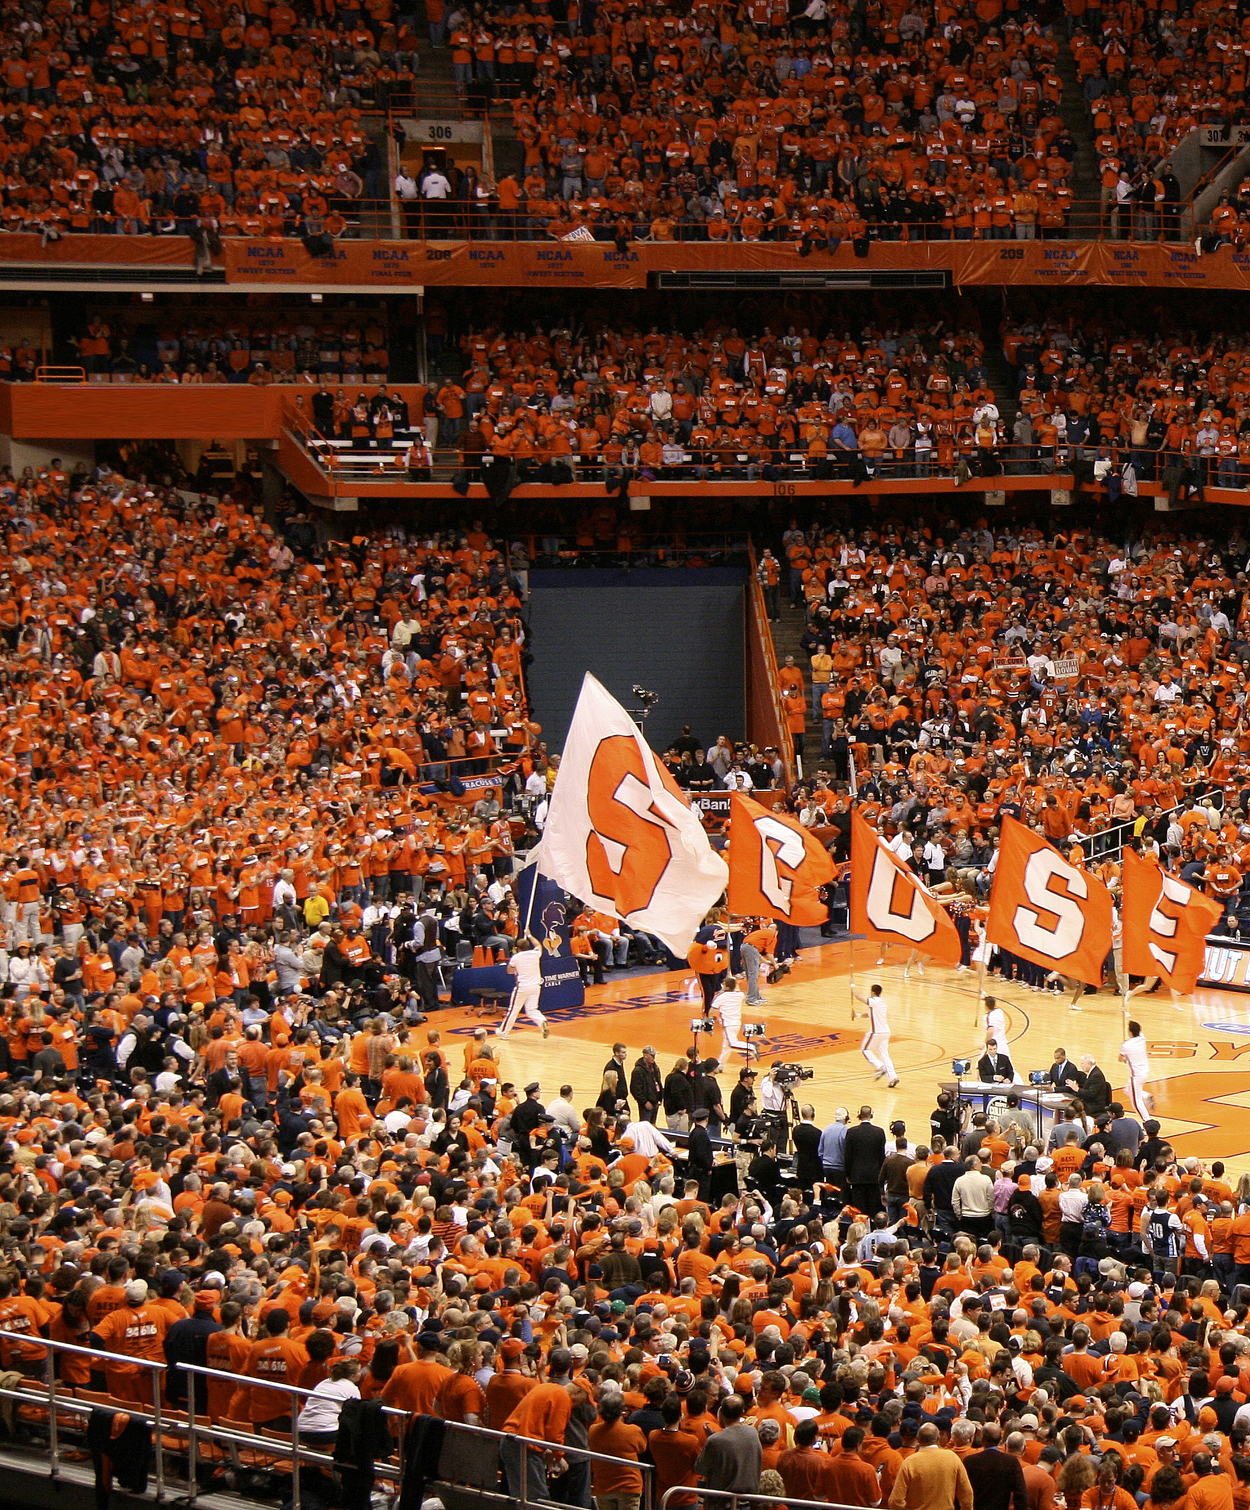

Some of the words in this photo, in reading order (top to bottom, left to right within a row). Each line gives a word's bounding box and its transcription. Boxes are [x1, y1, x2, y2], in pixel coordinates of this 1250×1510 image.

[428, 126, 452, 138] 306
[247, 247, 285, 258] NCAA
[372, 251, 409, 260] NCAA
[426, 250, 452, 260] 208
[469, 250, 505, 260] NCAA
[537, 251, 573, 260] NCAA
[603, 251, 640, 262] NCAA
[1000, 249, 1024, 260] 209
[1044, 250, 1078, 260] NCAA
[1113, 251, 1139, 260] NCAA
[1170, 252, 1198, 262] NCAA
[773, 484, 796, 496] 106
[1056, 666, 1078, 675] DOWN
[1045, 699, 1053, 707] 13
[860, 723, 869, 731] 23
[1012, 846, 1089, 959] S
[97, 1302, 119, 1311] BEST
